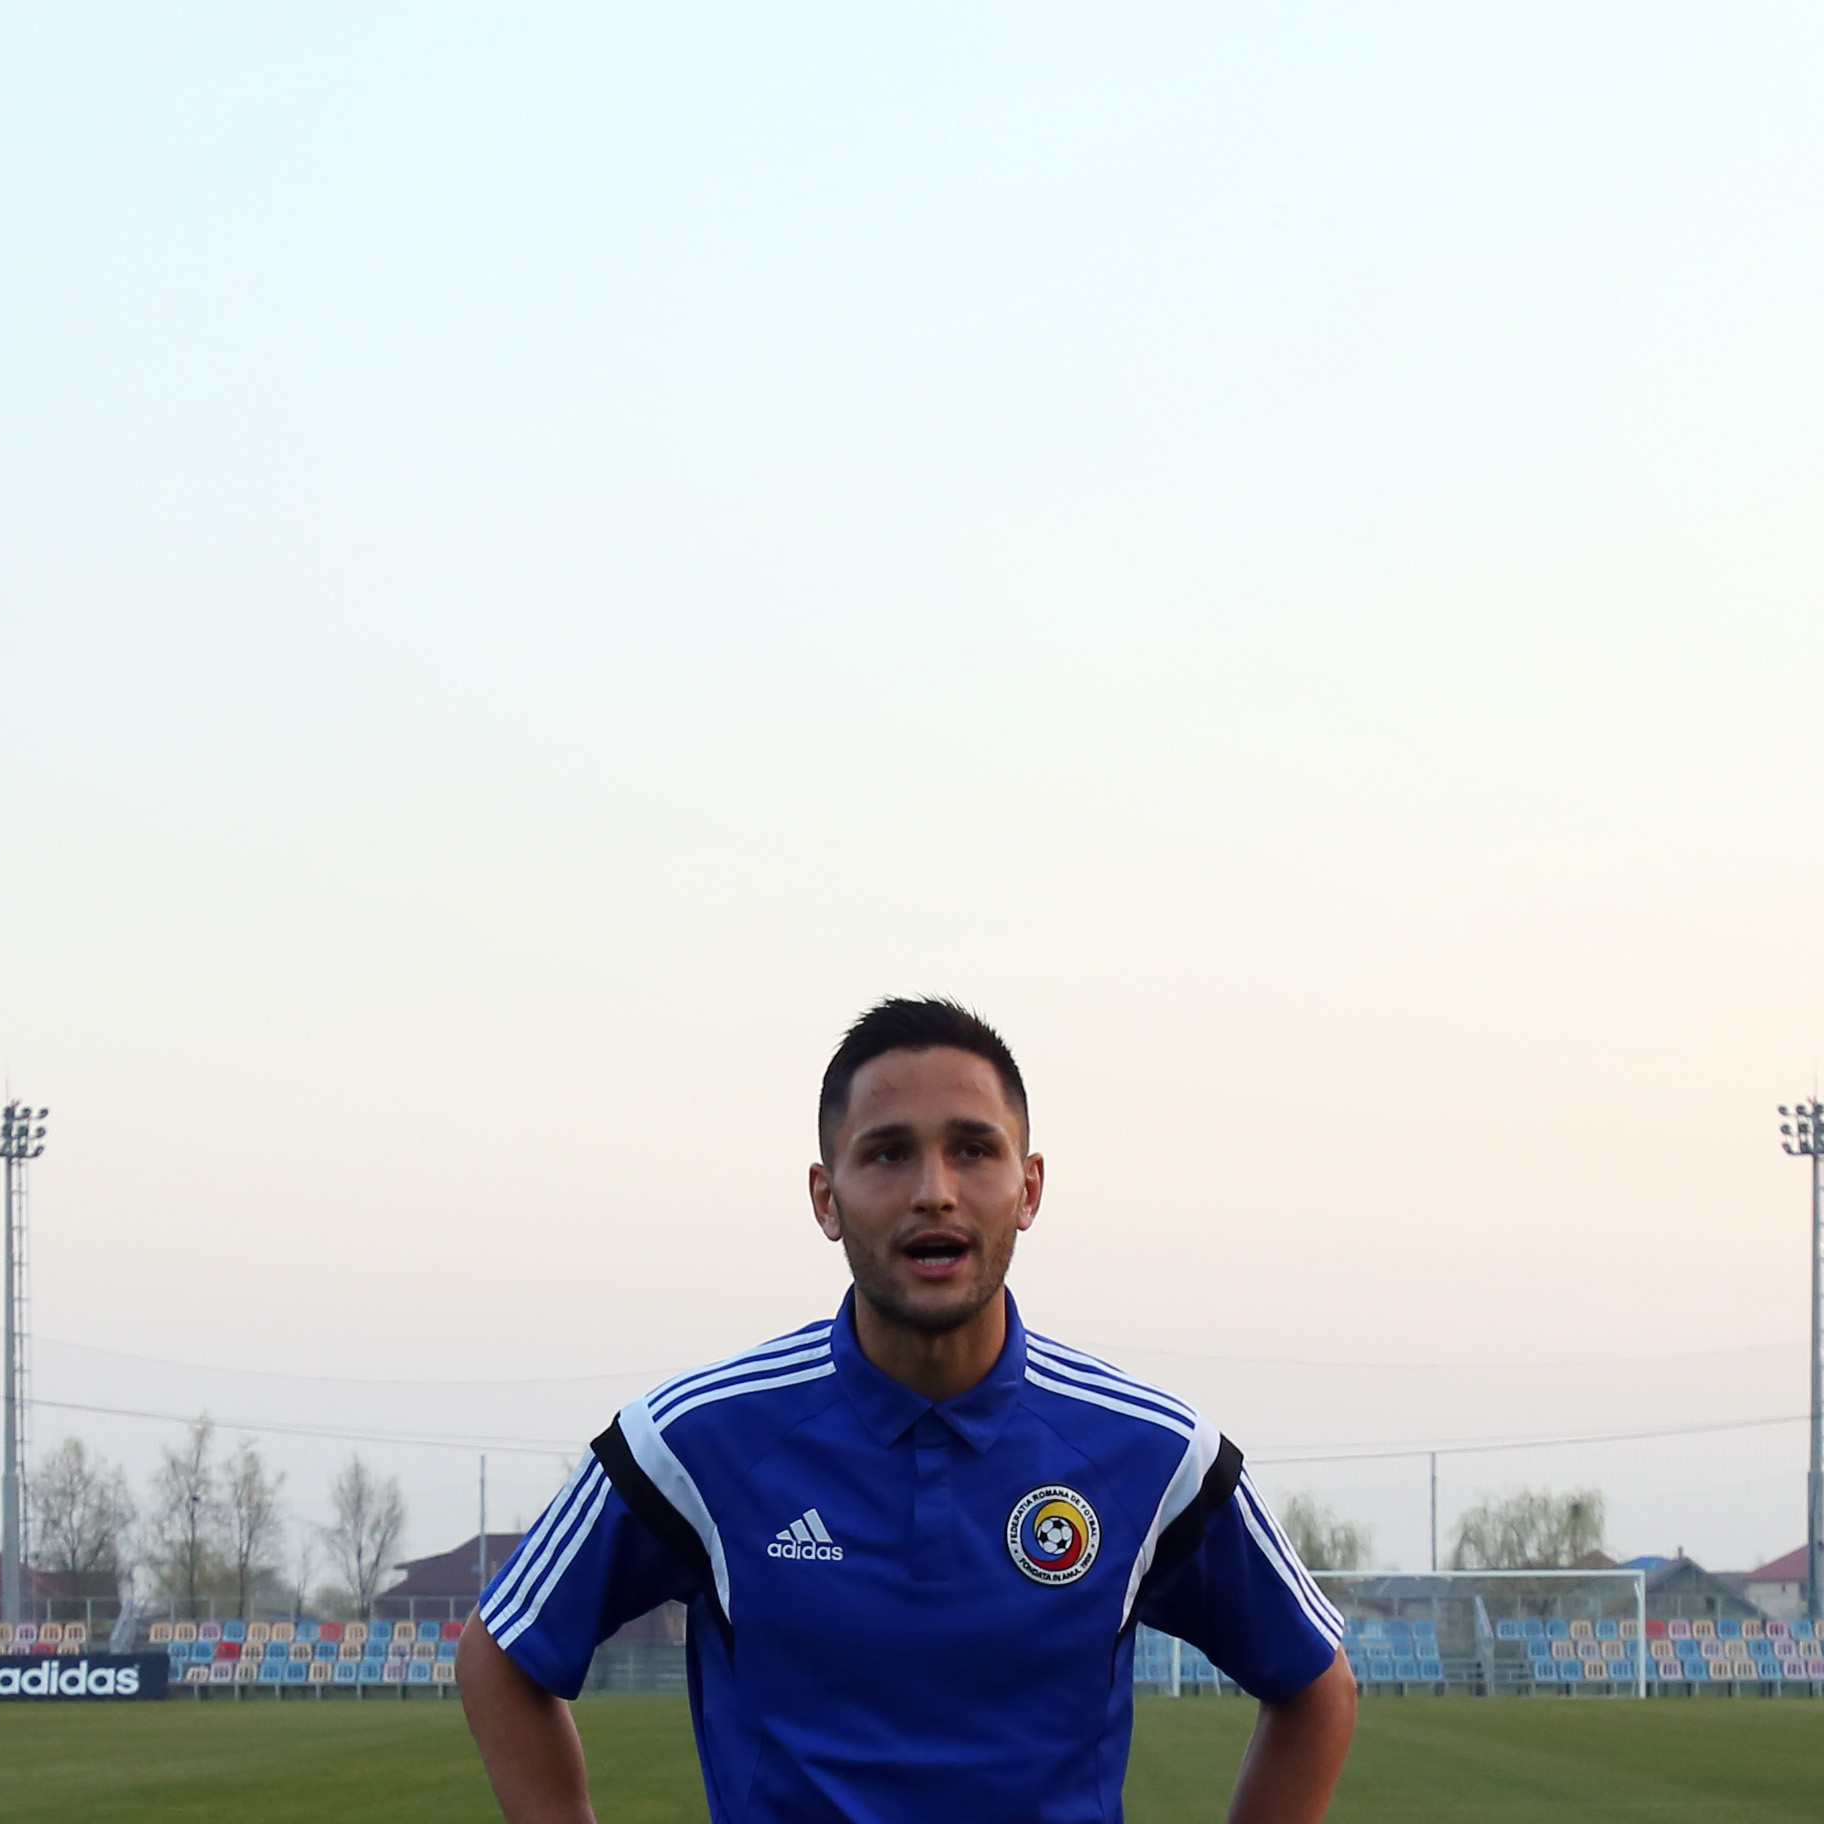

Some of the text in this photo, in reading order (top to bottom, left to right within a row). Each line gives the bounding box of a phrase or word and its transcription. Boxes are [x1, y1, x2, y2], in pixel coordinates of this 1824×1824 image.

[1032, 1489, 1069, 1501] ROMANA
[1070, 1494, 1081, 1506] DE
[1080, 1504, 1097, 1538] FOTBAL
[767, 1540, 844, 1561] adidas
